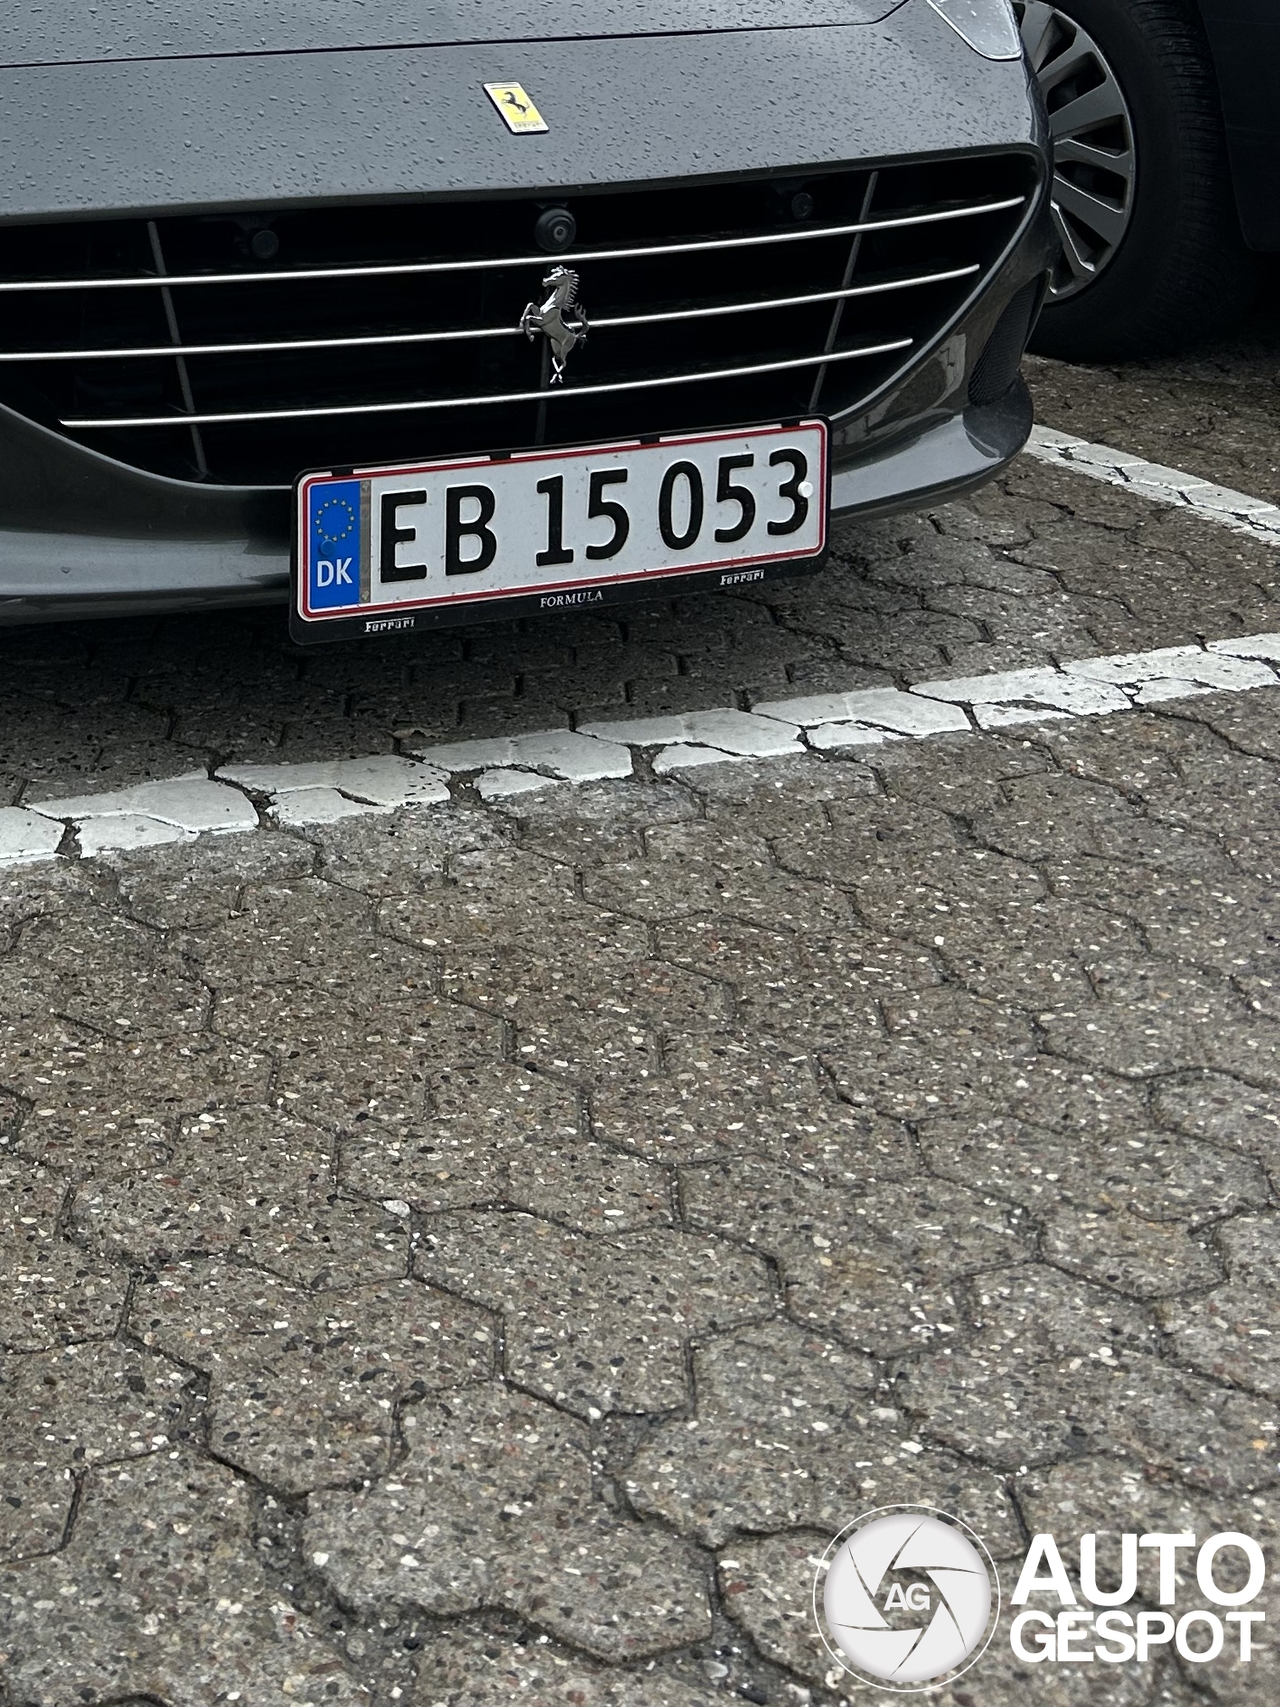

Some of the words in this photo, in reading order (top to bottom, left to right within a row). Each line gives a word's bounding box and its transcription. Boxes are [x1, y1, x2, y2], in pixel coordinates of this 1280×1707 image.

[381, 484, 497, 583] EB
[536, 468, 630, 566] 15
[659, 448, 809, 550] 053
[317, 557, 353, 587] DK
[720, 569, 765, 586] Ferrari
[540, 590, 604, 608] FORMULA
[364, 617, 415, 633] Ferrari
